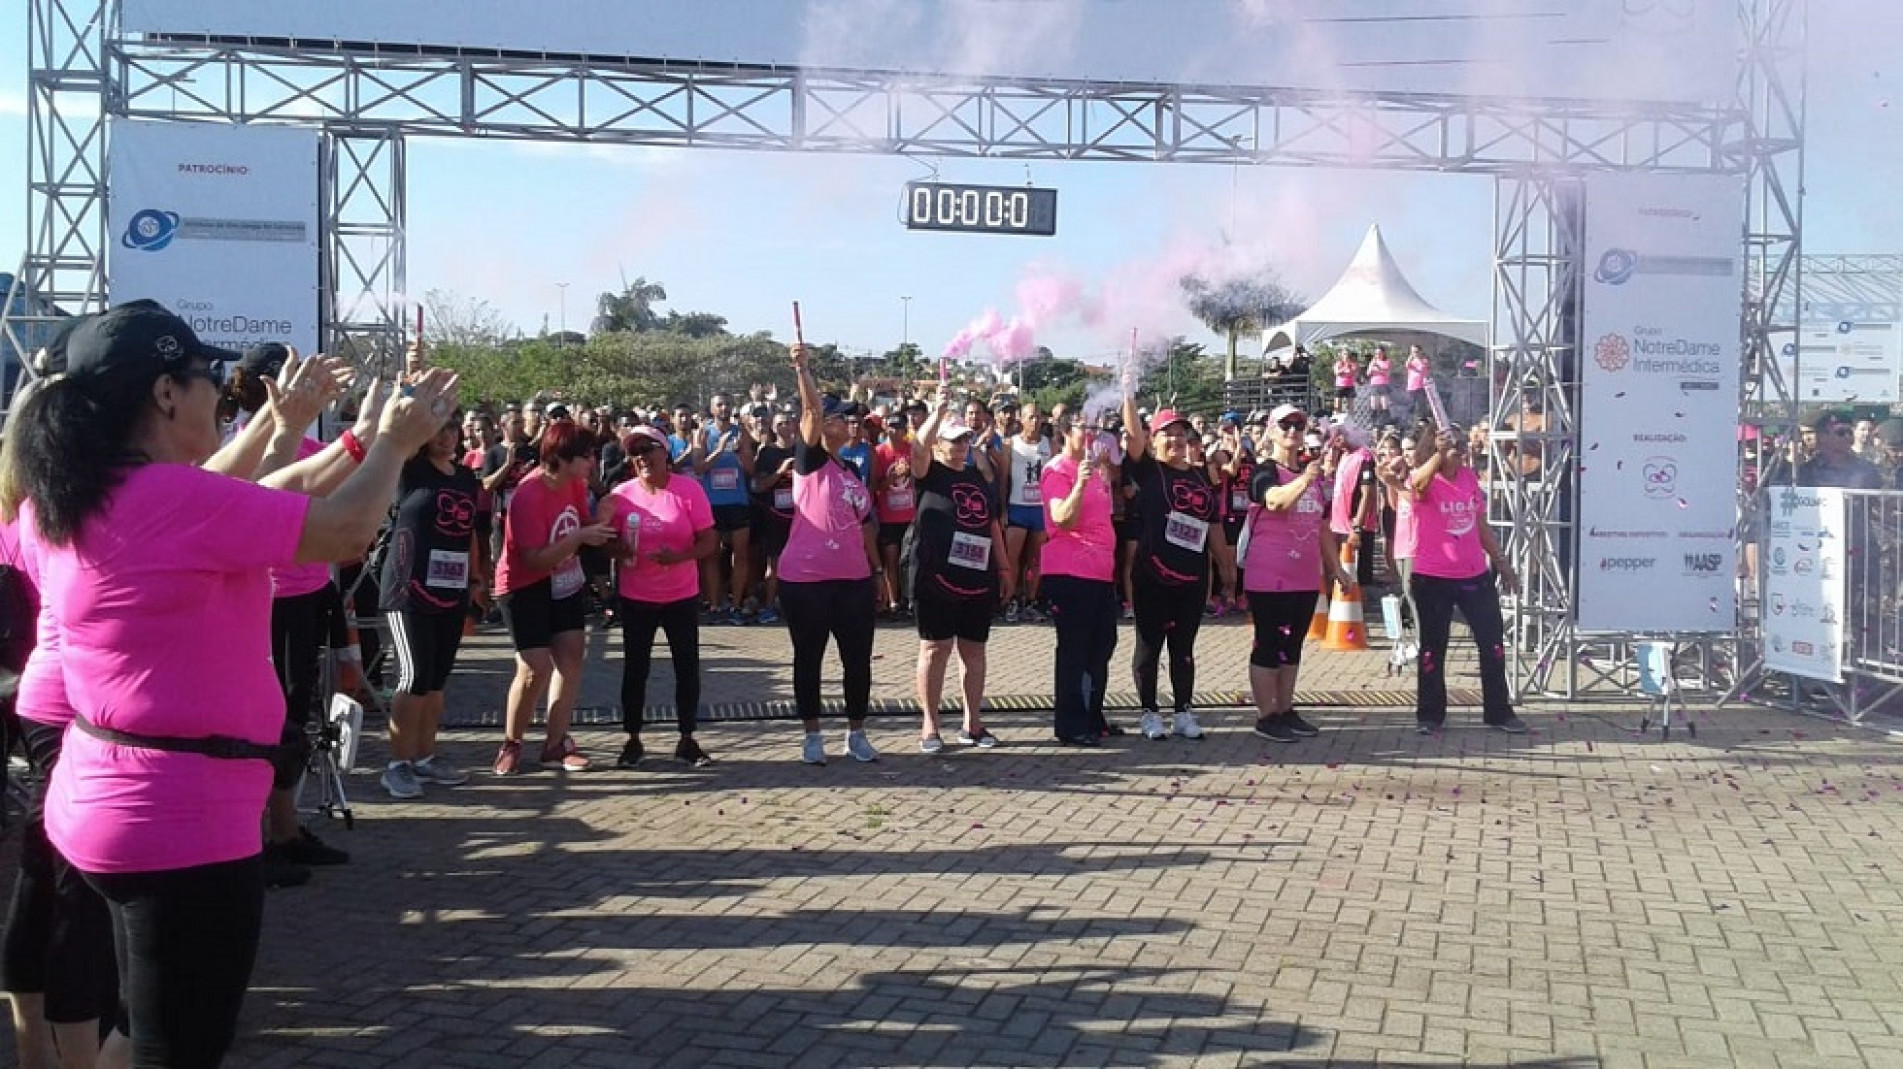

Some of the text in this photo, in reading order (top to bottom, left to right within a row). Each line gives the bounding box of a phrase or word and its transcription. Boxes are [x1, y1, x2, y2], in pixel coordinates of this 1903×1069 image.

[1634, 339, 1720, 356] NotreDame
[1633, 358, 1720, 373] Intermédica
[1607, 556, 1656, 571] pepper
